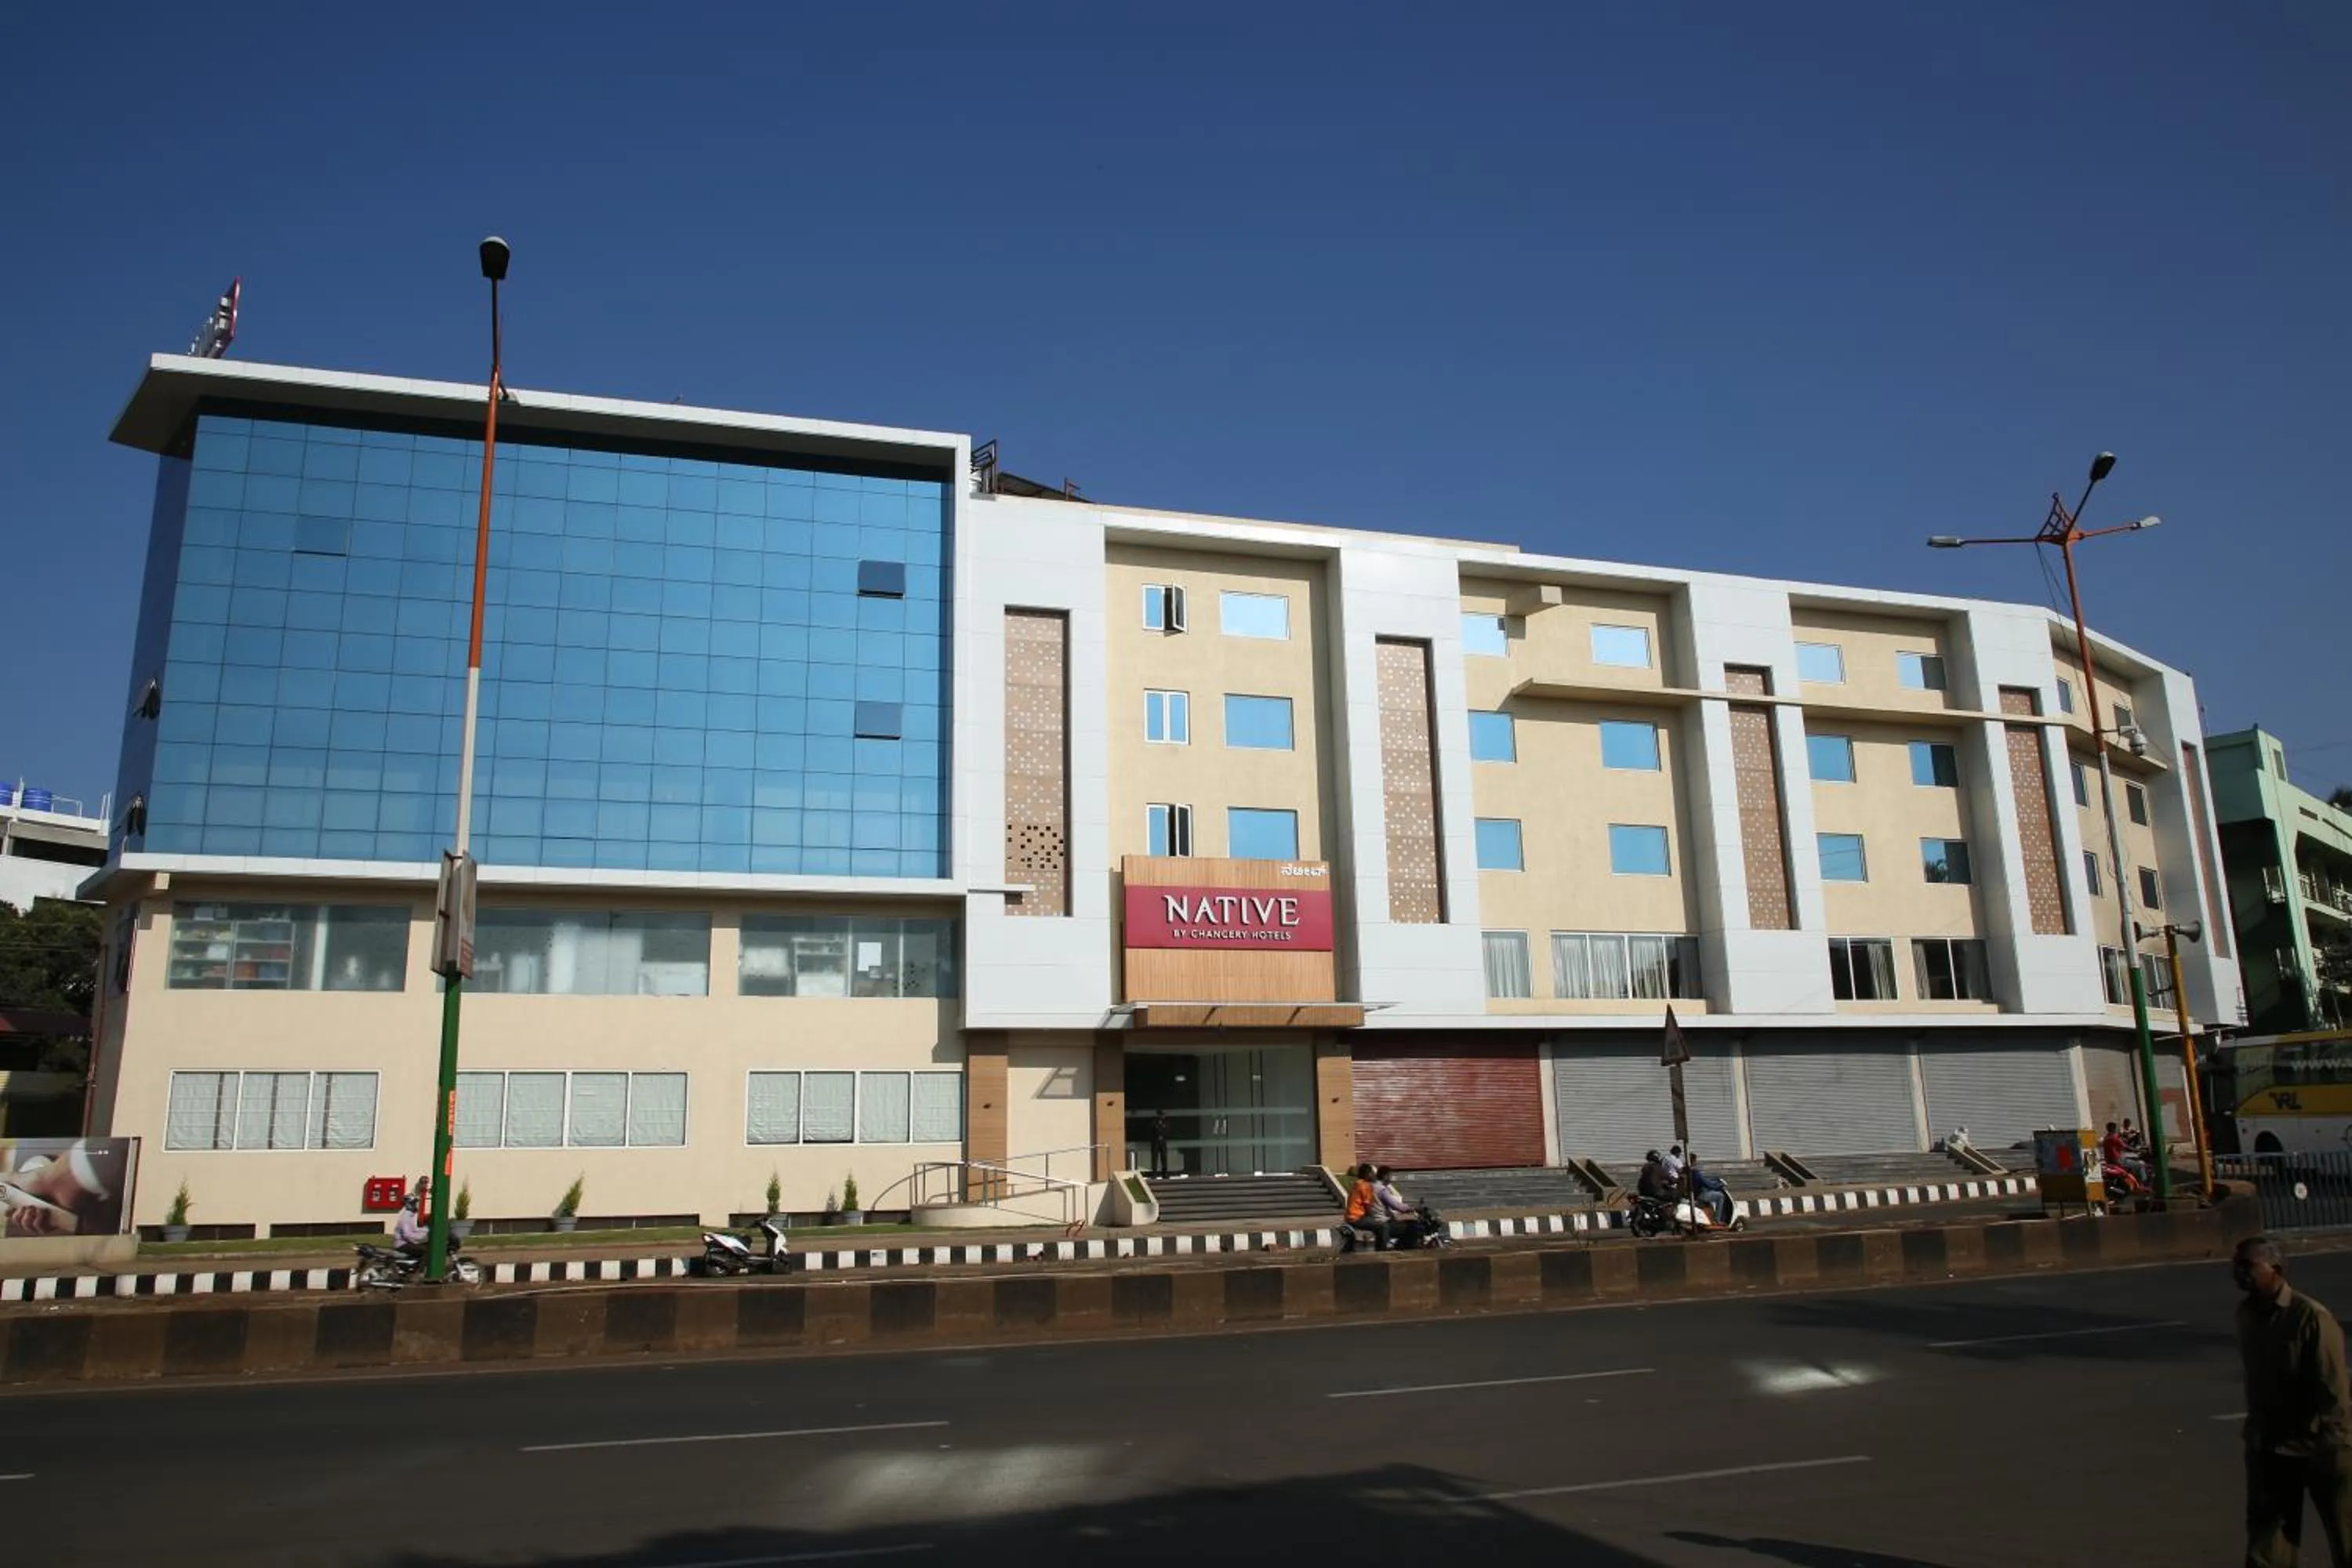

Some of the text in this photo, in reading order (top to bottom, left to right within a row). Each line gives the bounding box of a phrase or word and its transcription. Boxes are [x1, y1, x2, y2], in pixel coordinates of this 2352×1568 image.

[1163, 895, 1301, 927] NATIVE
[1174, 929, 1292, 941] BY CHANCERY HOTELS
